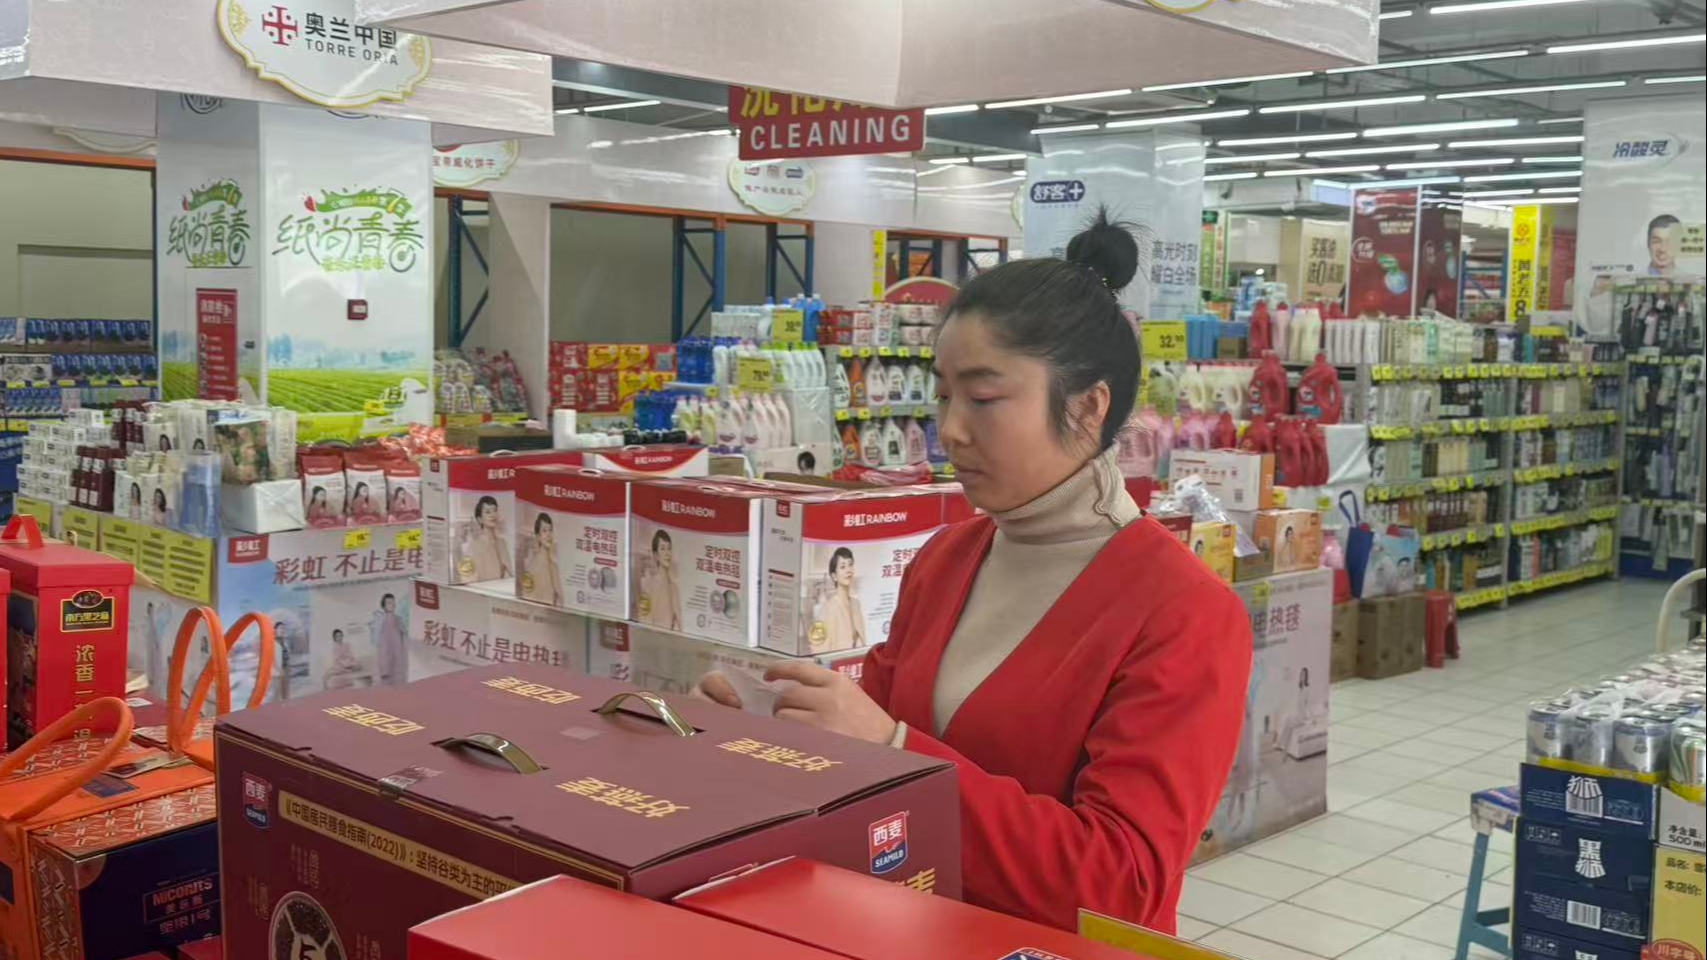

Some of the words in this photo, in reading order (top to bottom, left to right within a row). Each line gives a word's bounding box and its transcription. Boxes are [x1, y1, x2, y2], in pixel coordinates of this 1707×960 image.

[305, 12, 397, 49] 奥兰中国
[305, 38, 356, 58] TORRE
[751, 115, 911, 150] CLEANING
[1613, 139, 1671, 159] 冷酸灵
[272, 211, 425, 273] 纸尚青春
[680, 504, 716, 519] RAINBOW
[866, 511, 907, 525] RAINBOW
[893, 548, 921, 562] 定时
[273, 556, 328, 586] 彩虹
[873, 819, 903, 847] 西麦
[1669, 834, 1692, 847] 500
[875, 849, 904, 869] SEAMILD
